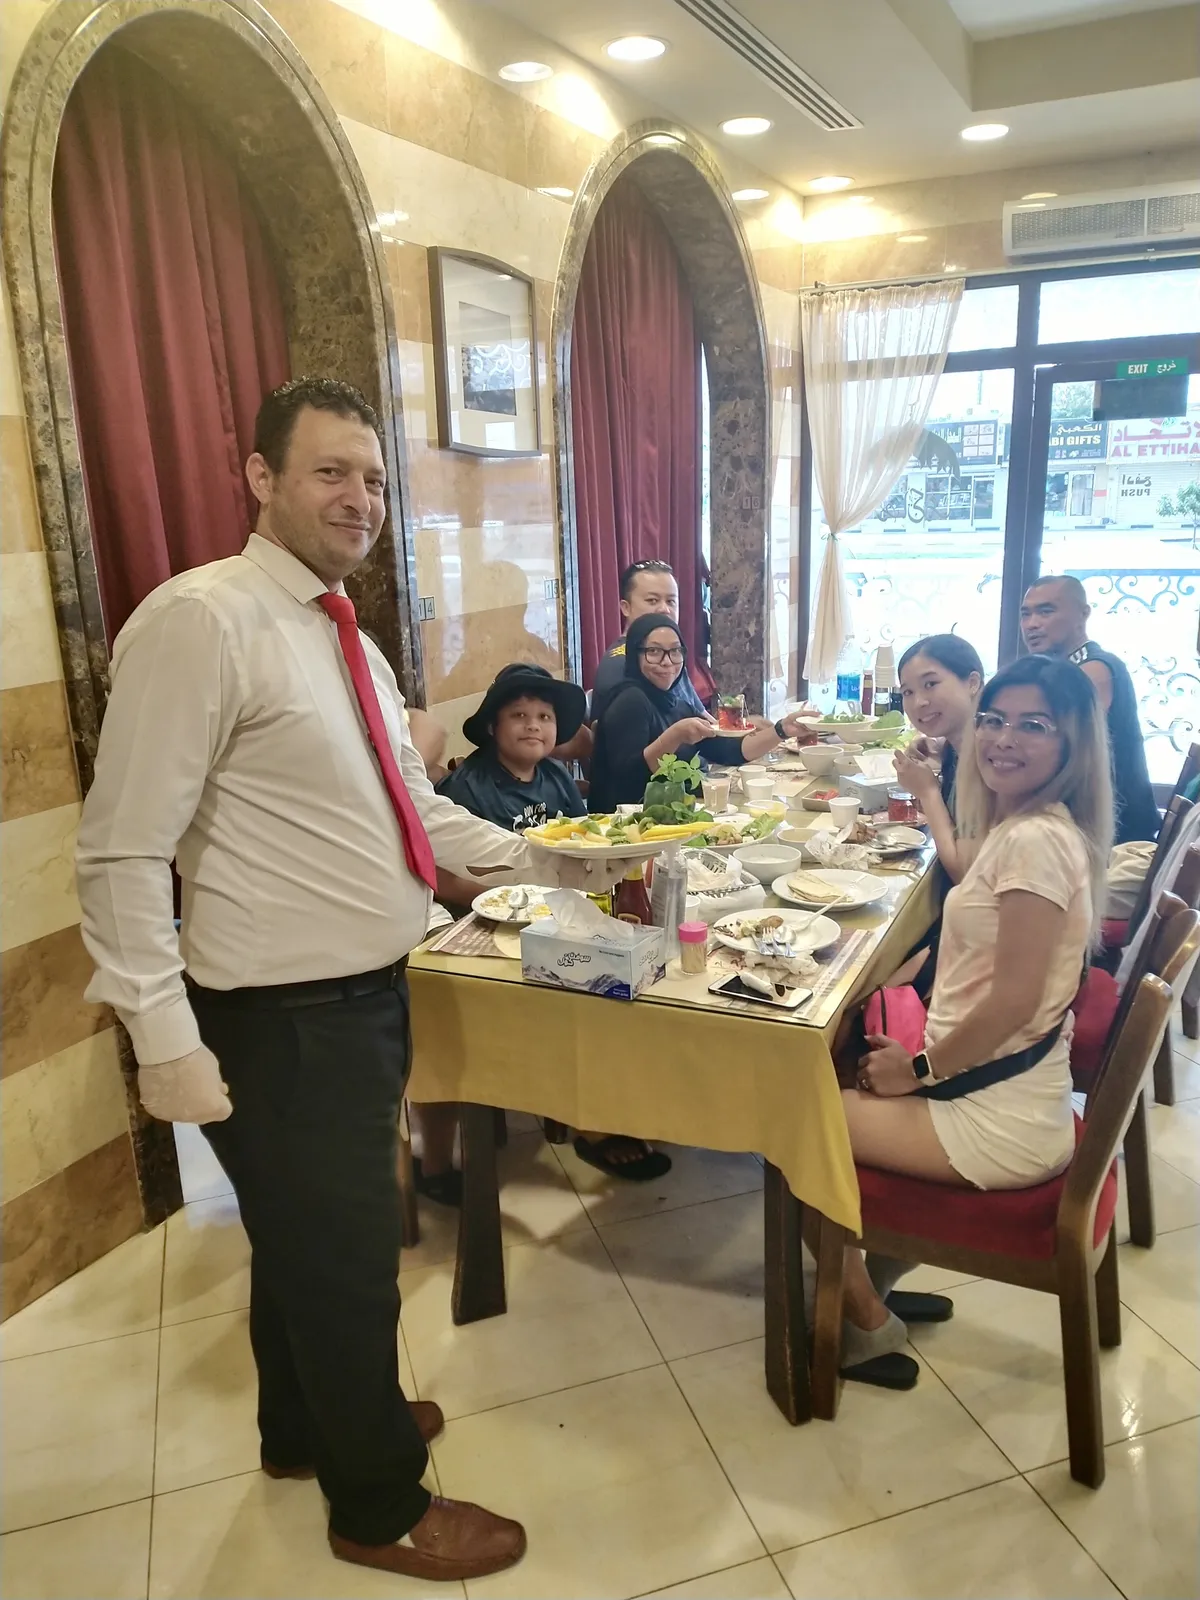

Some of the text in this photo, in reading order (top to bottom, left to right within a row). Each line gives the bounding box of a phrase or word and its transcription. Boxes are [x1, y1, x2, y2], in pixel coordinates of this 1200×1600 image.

[1128, 364, 1148, 374] EXIT
[1157, 360, 1176, 373] خروج
[1067, 435, 1101, 445] GIFTS
[1111, 445, 1132, 457] AL
[534, 801, 546, 814] FOR
